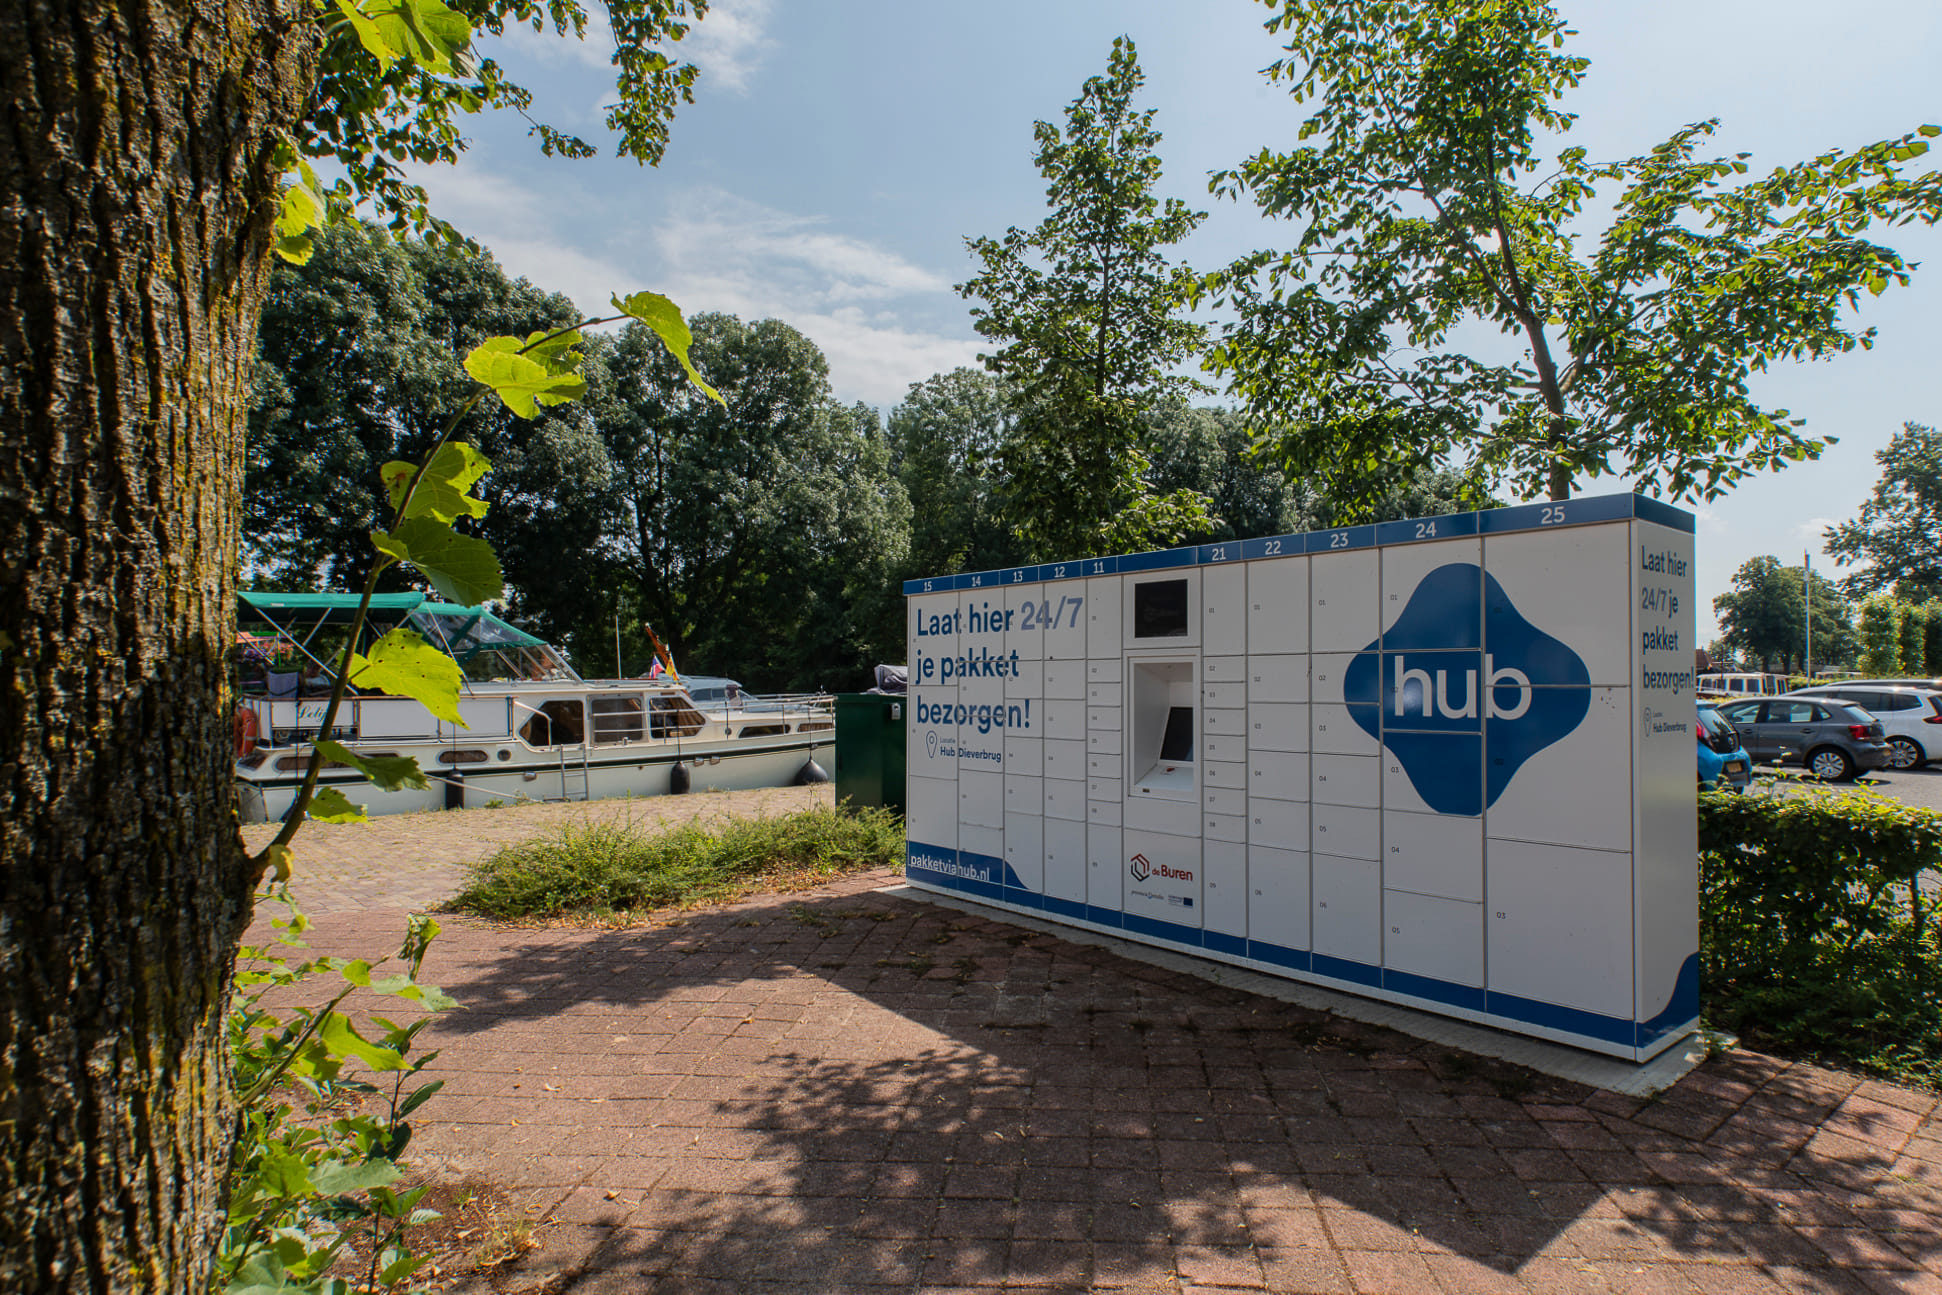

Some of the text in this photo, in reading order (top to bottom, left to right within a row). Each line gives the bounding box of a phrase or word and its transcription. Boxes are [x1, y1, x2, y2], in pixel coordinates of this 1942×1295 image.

[1541, 506, 1565, 524] 25
[1415, 521, 1437, 539] 24
[1265, 541, 1281, 555] 22
[1330, 533, 1348, 548] 23
[1211, 548, 1226, 561] 21
[1641, 544, 1687, 577] Laat hier
[1054, 566, 1065, 578] 12
[1093, 561, 1104, 574] 11
[971, 576, 981, 587] 14
[1013, 571, 1023, 582] 13
[923, 581, 932, 592] 15
[1641, 586, 1679, 619] 24/7 je
[917, 596, 1083, 636] Laat hier 24/7
[1642, 625, 1679, 655] pakket
[915, 647, 1019, 685] je pakket
[1394, 654, 1532, 720] hub
[1643, 664, 1694, 695] bezorgen!
[917, 695, 1030, 734] bezorgen!
[940, 746, 956, 757] Hub
[958, 747, 1002, 763] Dieverbrug
[1161, 864, 1193, 881] Buren
